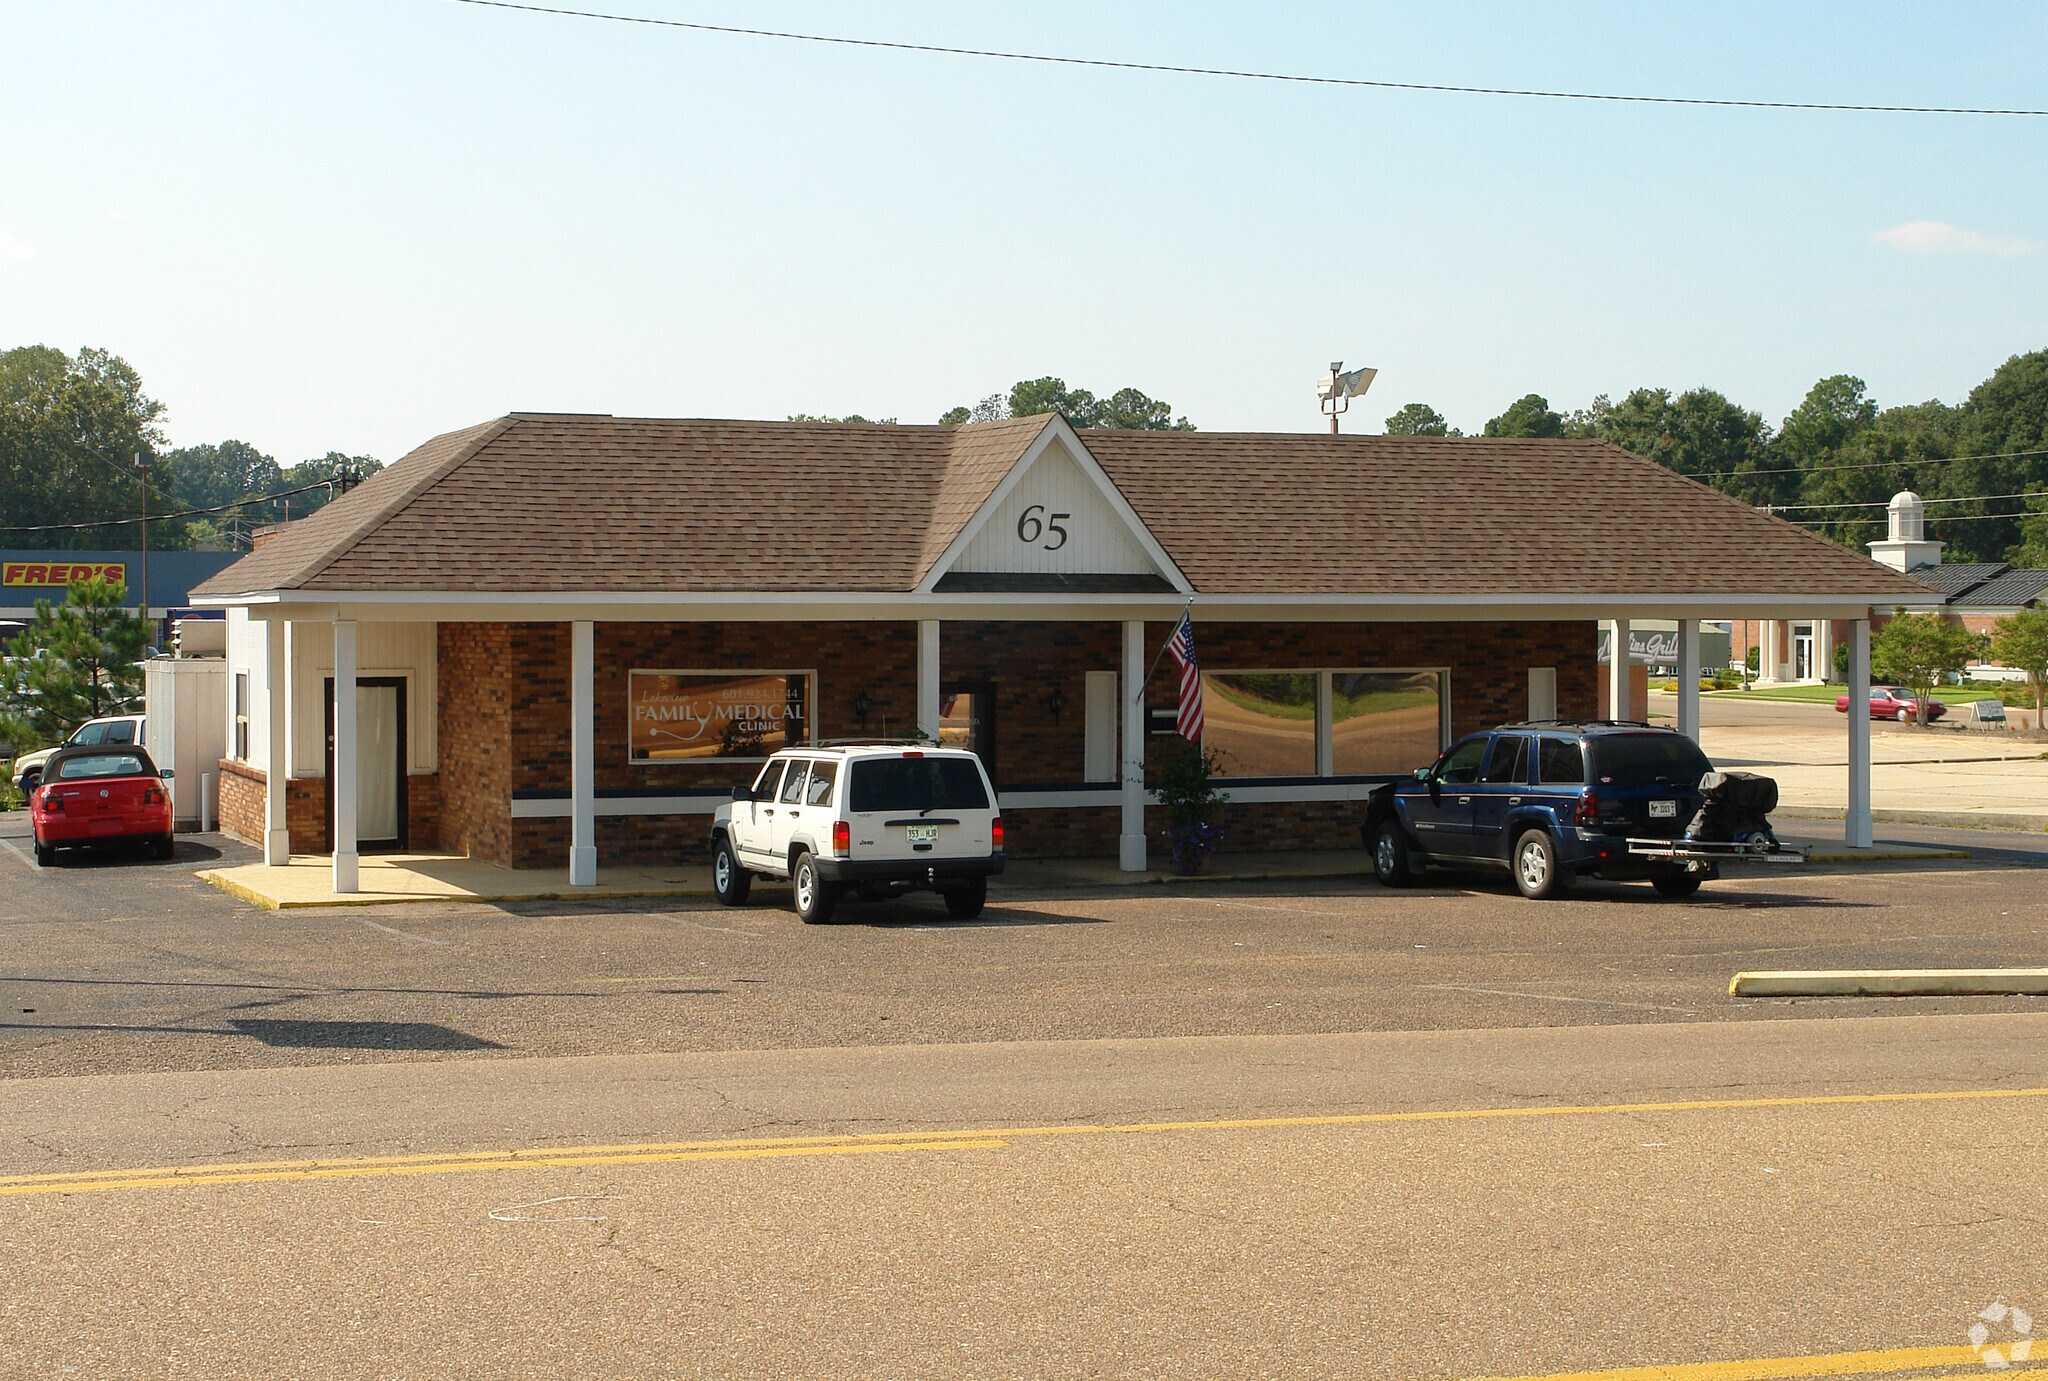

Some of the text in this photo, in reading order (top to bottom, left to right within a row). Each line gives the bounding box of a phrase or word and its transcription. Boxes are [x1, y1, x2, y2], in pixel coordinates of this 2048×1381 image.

[1017, 505, 1071, 551] 65
[4, 565, 124, 585] FRED'S
[642, 690, 690, 703] Lakeview
[722, 688, 798, 700] 601.924.1744
[635, 701, 805, 732] FAMILY MEDICAL
[738, 721, 781, 731] CLINIC
